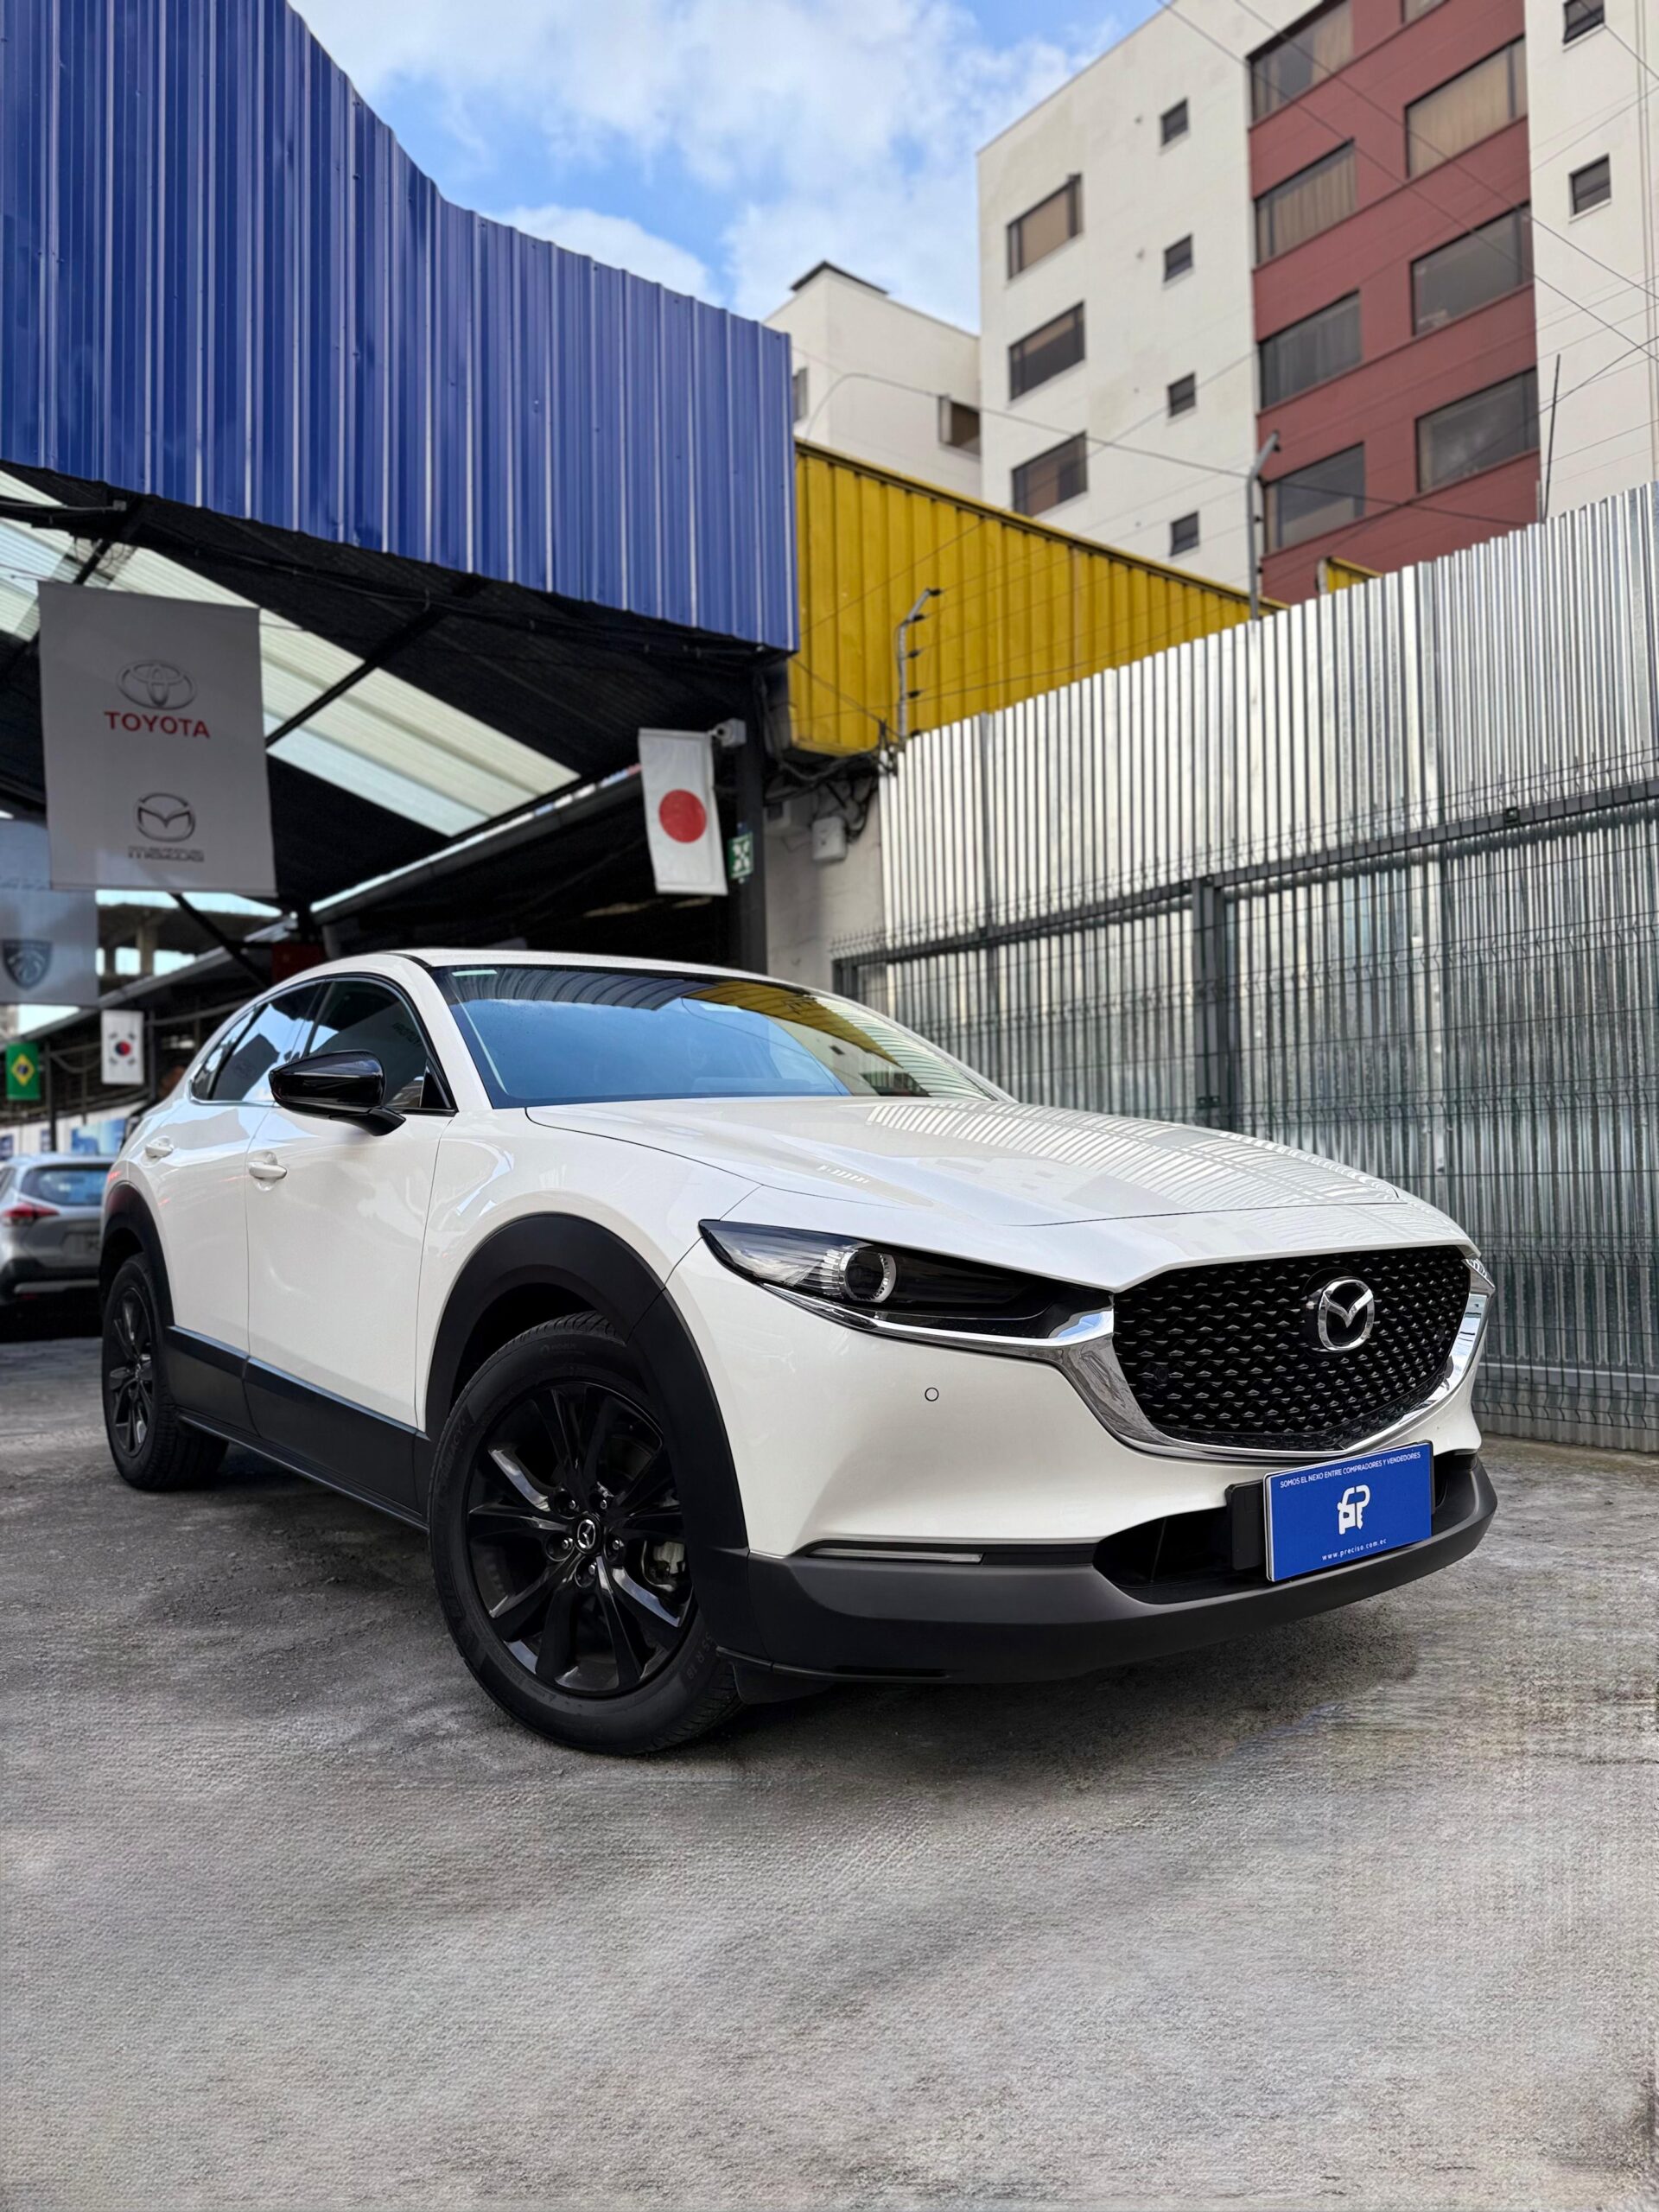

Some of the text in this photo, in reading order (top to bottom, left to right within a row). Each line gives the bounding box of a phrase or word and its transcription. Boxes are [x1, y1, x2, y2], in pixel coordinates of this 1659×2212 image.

[104, 711, 210, 738] TOYOTA
[1280, 1477, 1300, 1489] SOMOS
[1308, 1471, 1324, 1482] NEXO
[1324, 1468, 1343, 1478] ENTRE
[1342, 1459, 1382, 1475] COMPRADORES
[1386, 1451, 1421, 1465] VENDEDORES
[1321, 1538, 1387, 1560] www.preciso.com.ec
